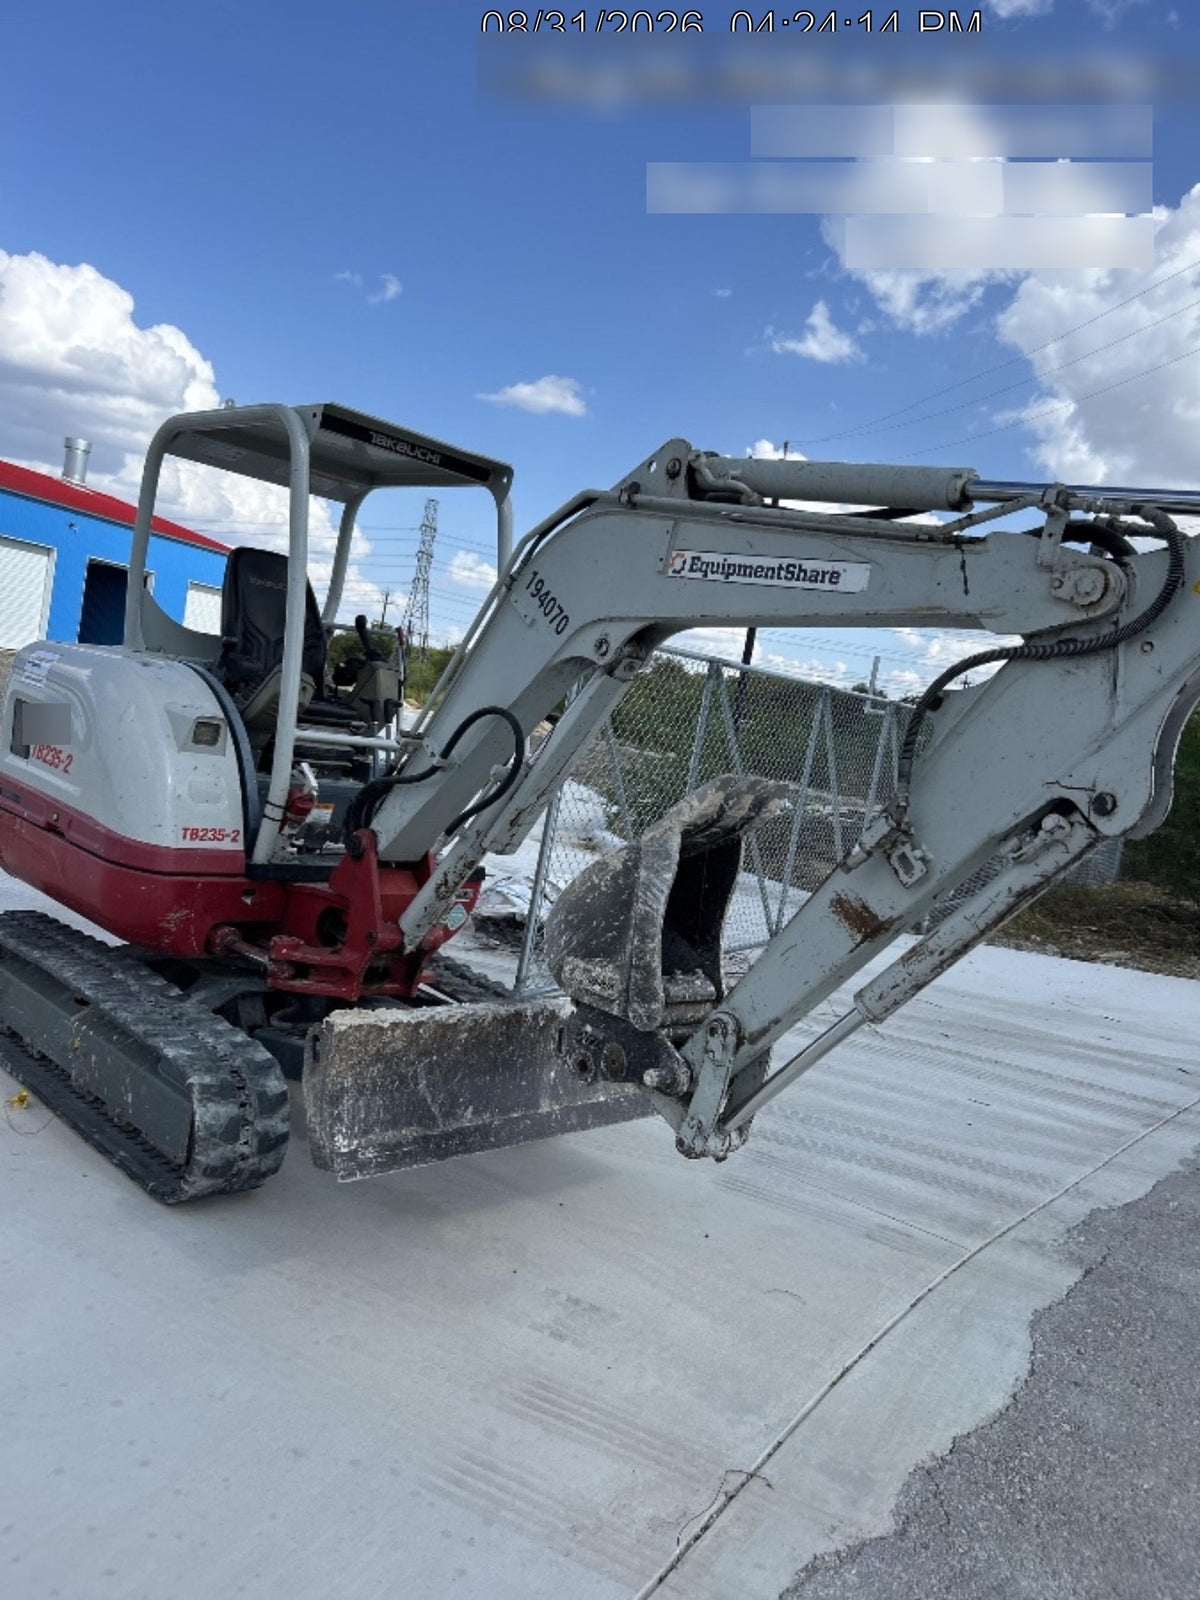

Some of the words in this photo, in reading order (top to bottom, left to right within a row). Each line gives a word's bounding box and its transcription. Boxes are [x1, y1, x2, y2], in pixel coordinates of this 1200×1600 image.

[688, 556, 841, 585] EquipmentShare
[525, 570, 570, 636] 194070
[181, 827, 241, 843] TB235-2
